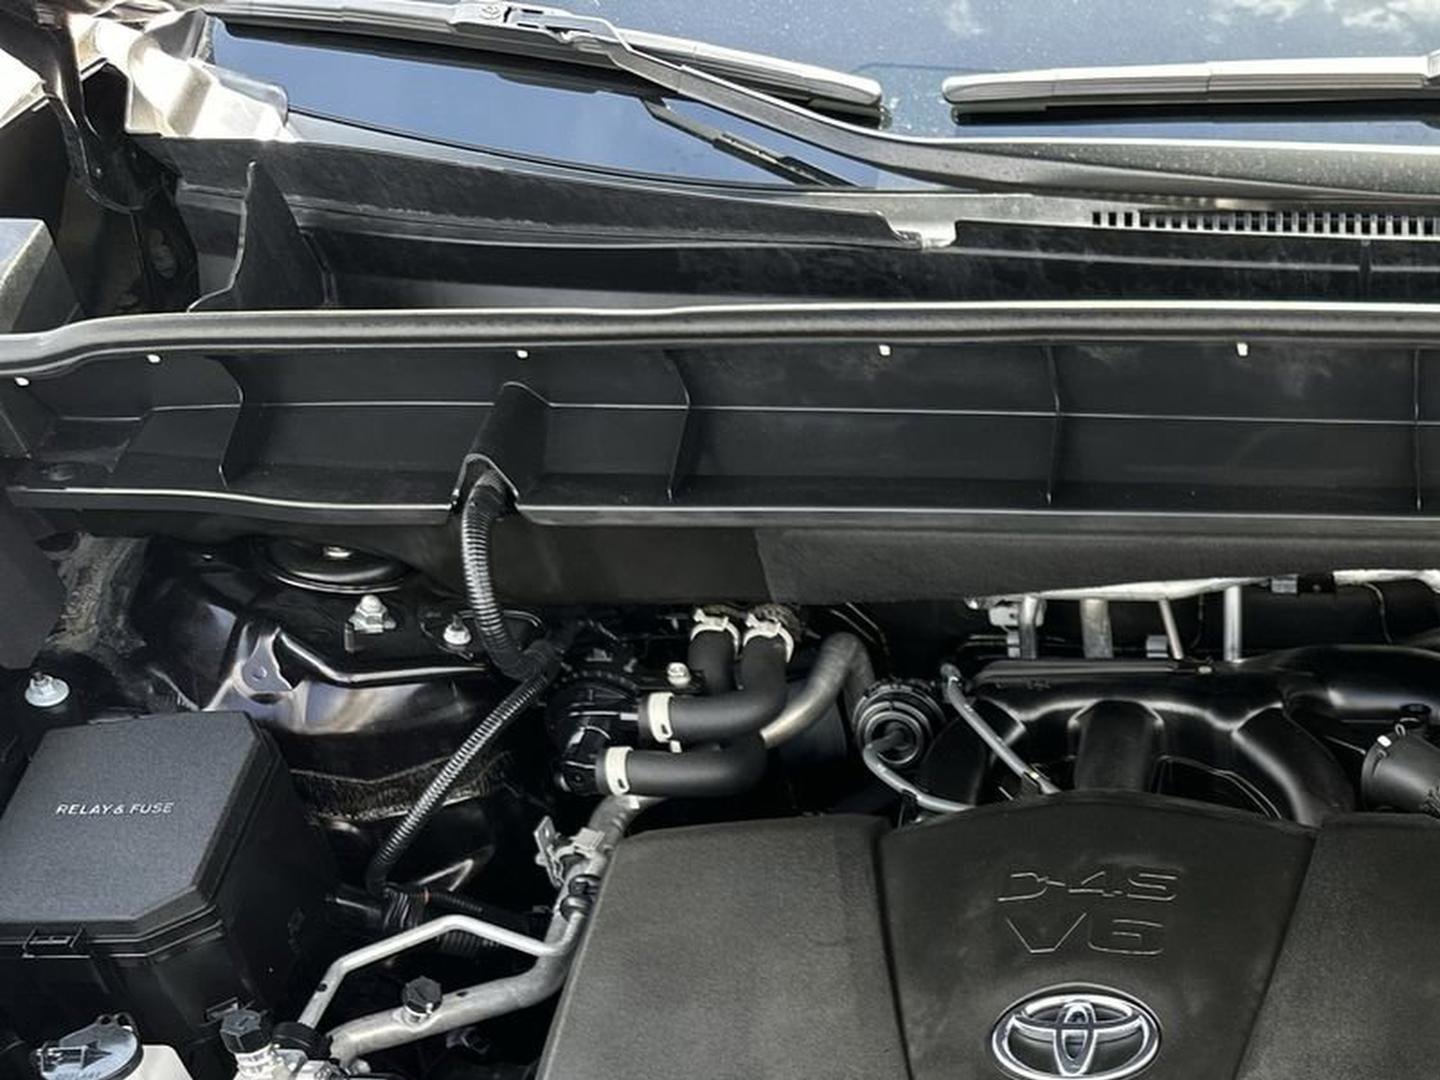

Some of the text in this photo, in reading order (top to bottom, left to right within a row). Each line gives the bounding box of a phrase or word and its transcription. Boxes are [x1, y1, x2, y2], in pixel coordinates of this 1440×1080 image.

[56, 803, 114, 815] RELAY
[129, 801, 175, 814] FUSE
[1004, 912, 1168, 956] V6
